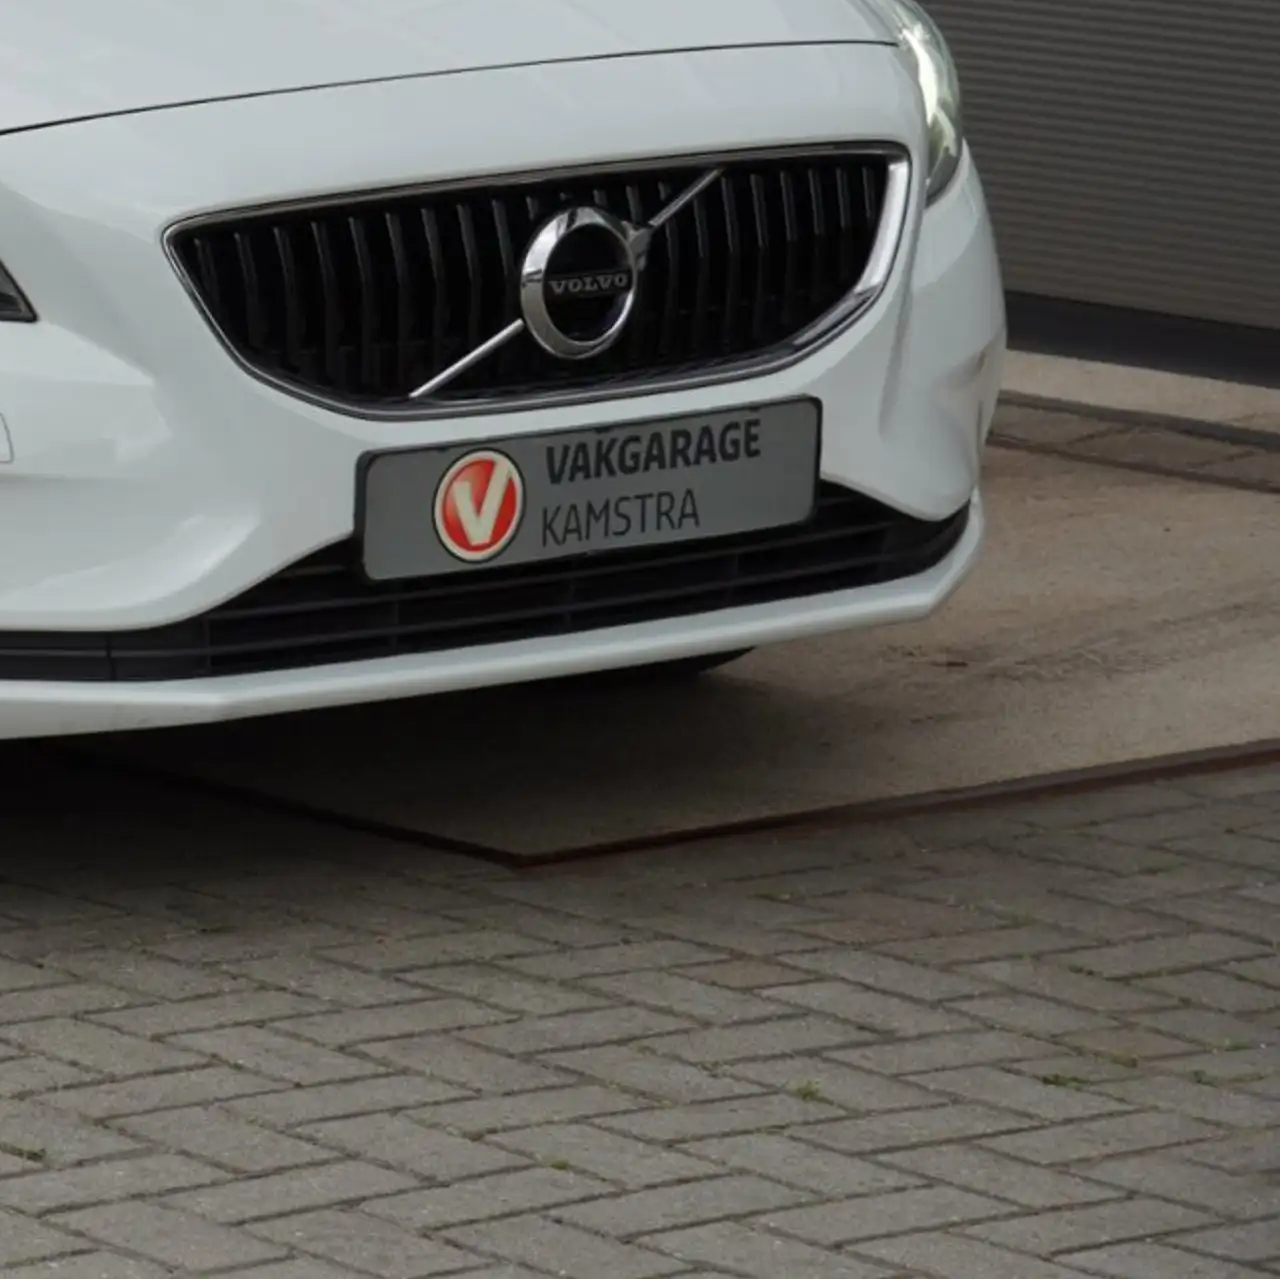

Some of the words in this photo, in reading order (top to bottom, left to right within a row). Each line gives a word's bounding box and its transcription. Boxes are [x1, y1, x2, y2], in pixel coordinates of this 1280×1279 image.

[548, 272, 628, 295] VOLVO
[546, 419, 761, 485] VAKGARAGE
[452, 455, 516, 546] V
[541, 488, 701, 548] KAMSTRA
